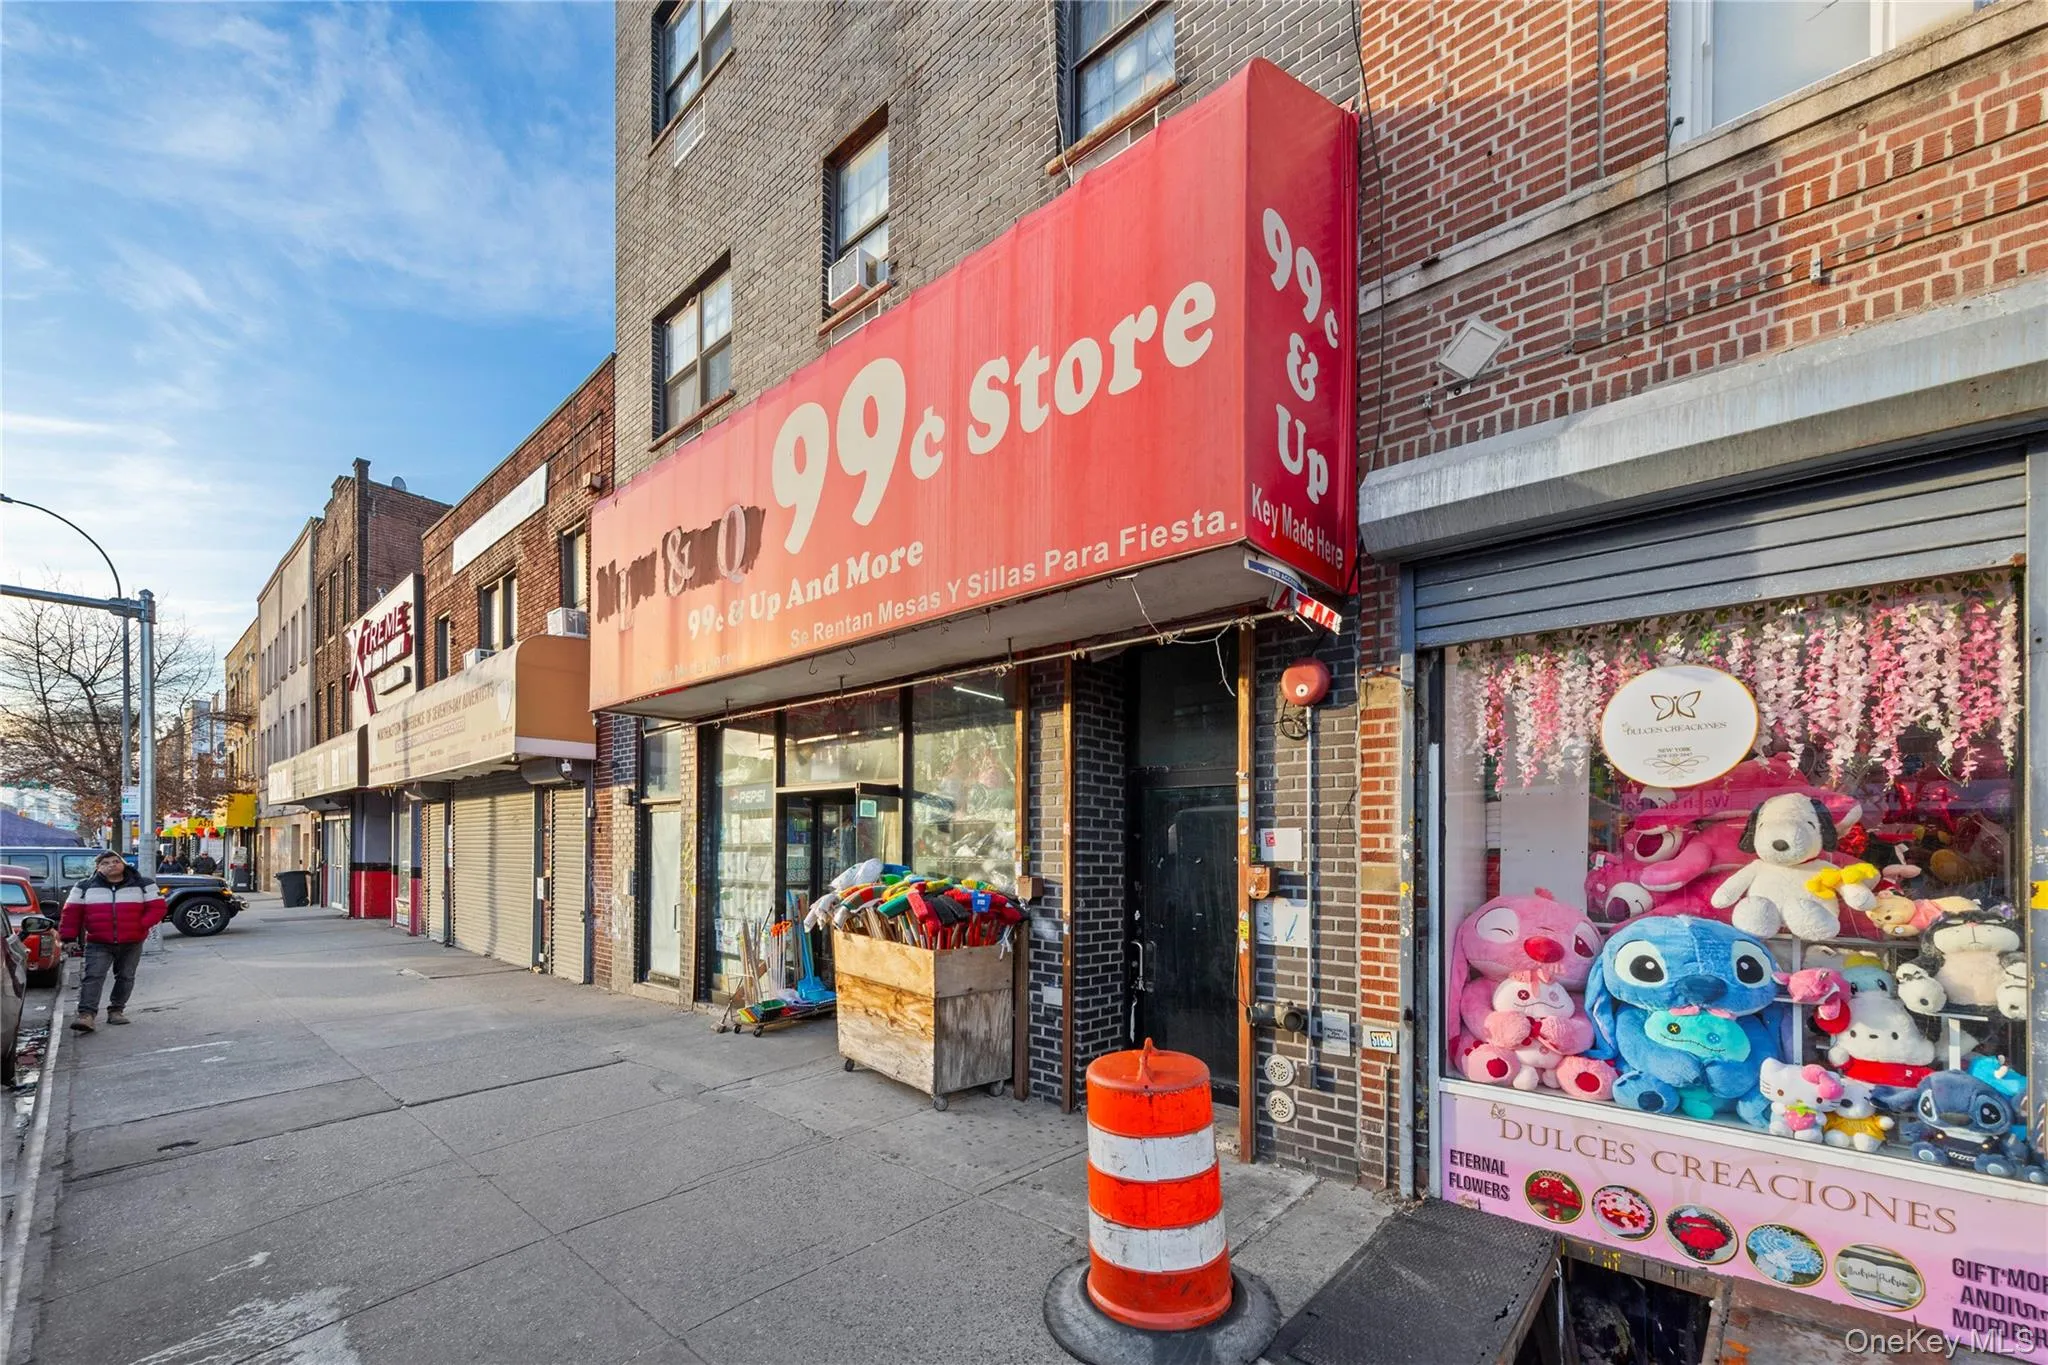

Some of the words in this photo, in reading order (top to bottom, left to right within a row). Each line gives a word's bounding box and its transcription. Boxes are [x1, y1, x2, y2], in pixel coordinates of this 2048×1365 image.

[967, 281, 1216, 455] Store
[1286, 332, 1319, 402] &
[1275, 403, 1329, 505] Up
[716, 503, 746, 585] Q
[1252, 483, 1279, 539] Key
[1282, 503, 1314, 552] Made
[1317, 526, 1344, 570] Here
[728, 599, 745, 627] &
[750, 590, 781, 621] Up
[786, 563, 840, 609] And
[846, 541, 924, 589] More
[790, 628, 809, 649] Se
[814, 611, 873, 643] Rentan
[878, 591, 941, 625] Mesas
[948, 578, 962, 604] Y
[967, 562, 1035, 598] Sillas
[1044, 541, 1109, 577] Para
[1119, 508, 1237, 557] Fiesta.
[739, 789, 766, 804] PEPSI
[1448, 1171, 1511, 1202] FLOWERS
[1450, 1149, 1509, 1178] ETERNAL
[1498, 1119, 1637, 1166] DULCES
[1651, 1150, 1957, 1235] CREACIONES
